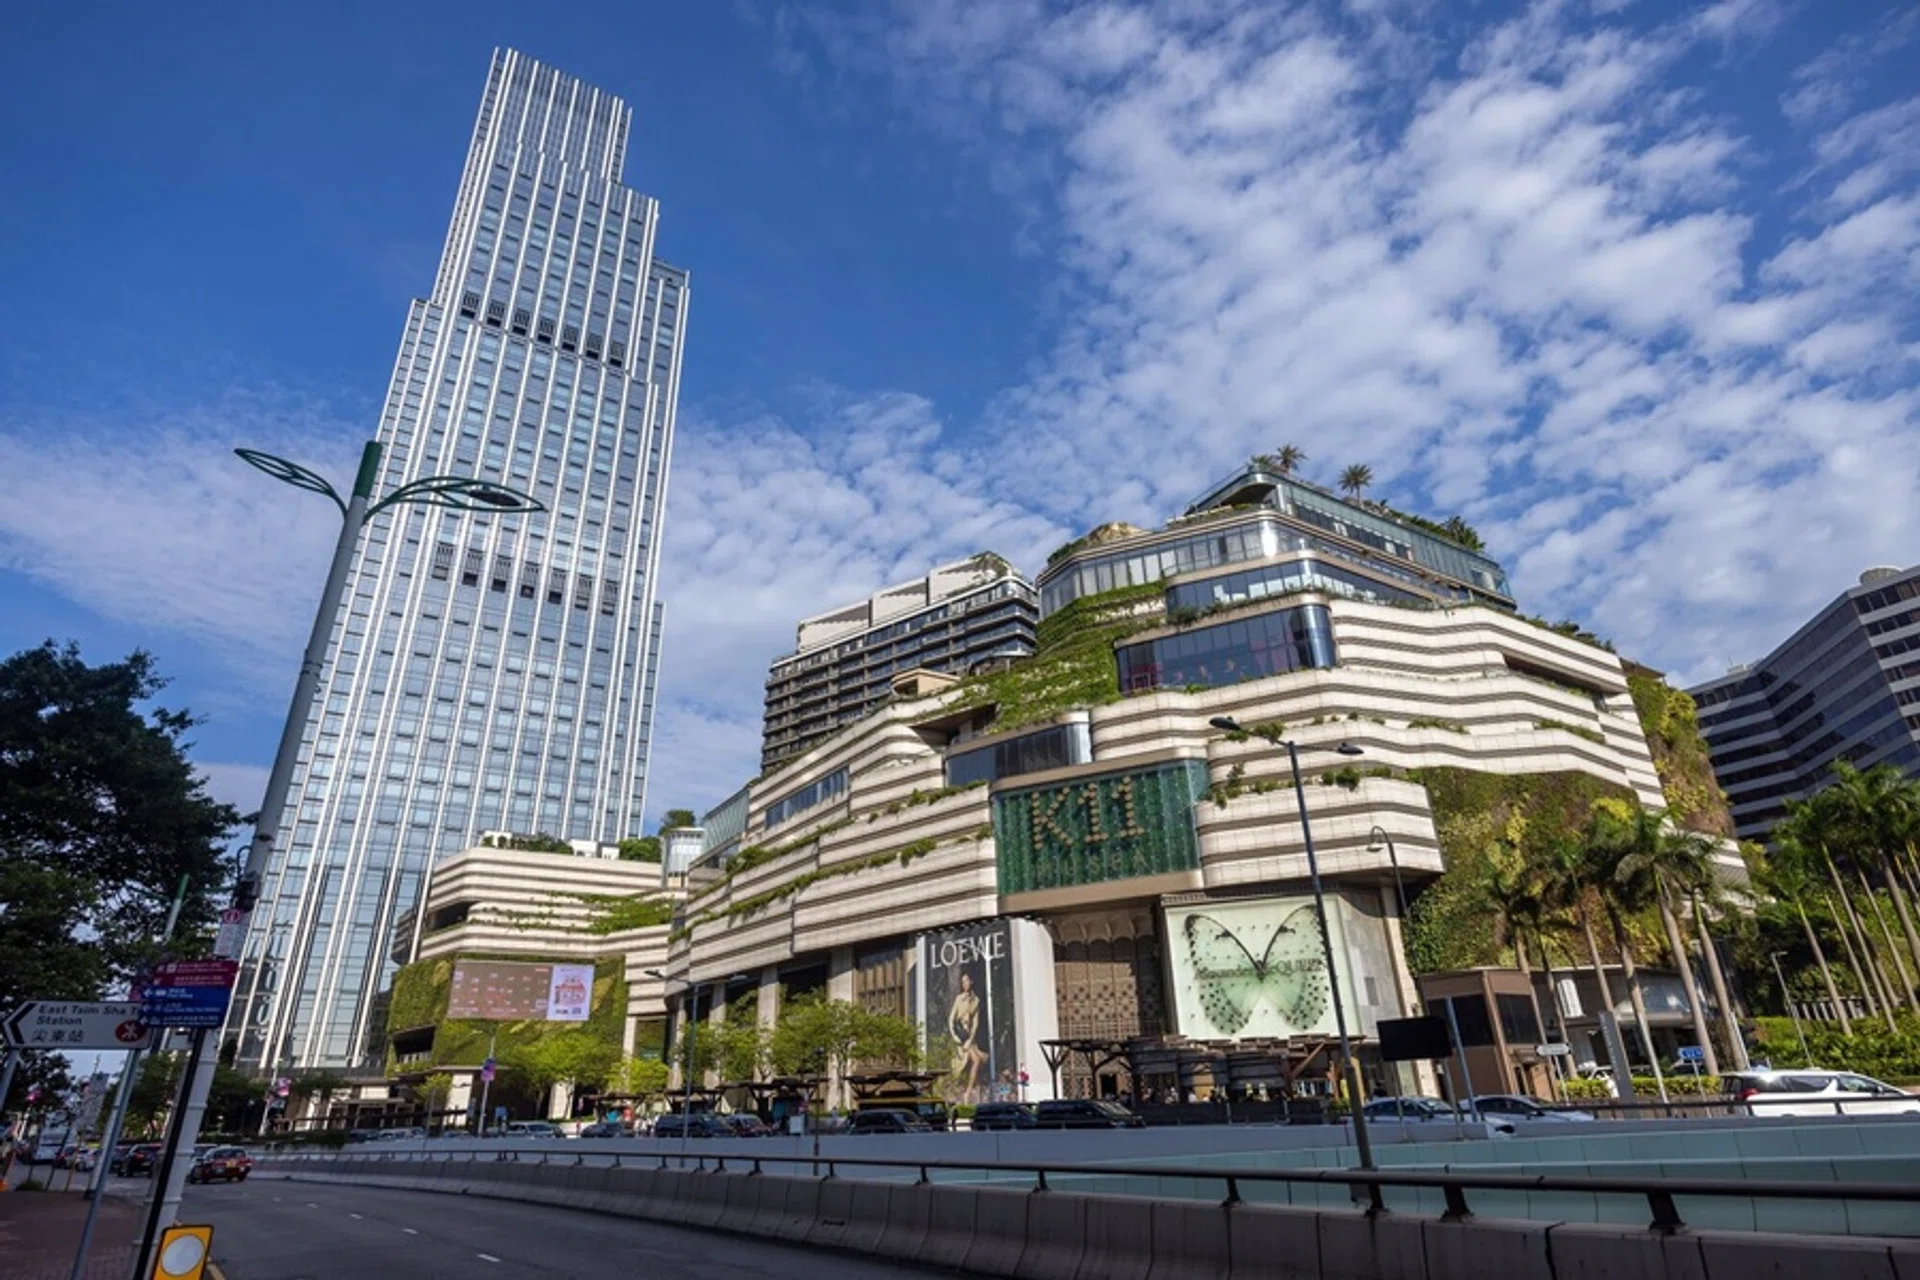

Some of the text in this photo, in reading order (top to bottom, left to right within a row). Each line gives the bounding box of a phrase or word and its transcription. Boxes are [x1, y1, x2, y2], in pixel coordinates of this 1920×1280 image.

[1031, 775, 1145, 850] K11
[931, 932, 1005, 969] LOEWE
[36, 1016, 82, 1025] Station
[38, 1004, 67, 1014] East
[72, 1005, 99, 1014] Tsim
[103, 1005, 127, 1015] Sha
